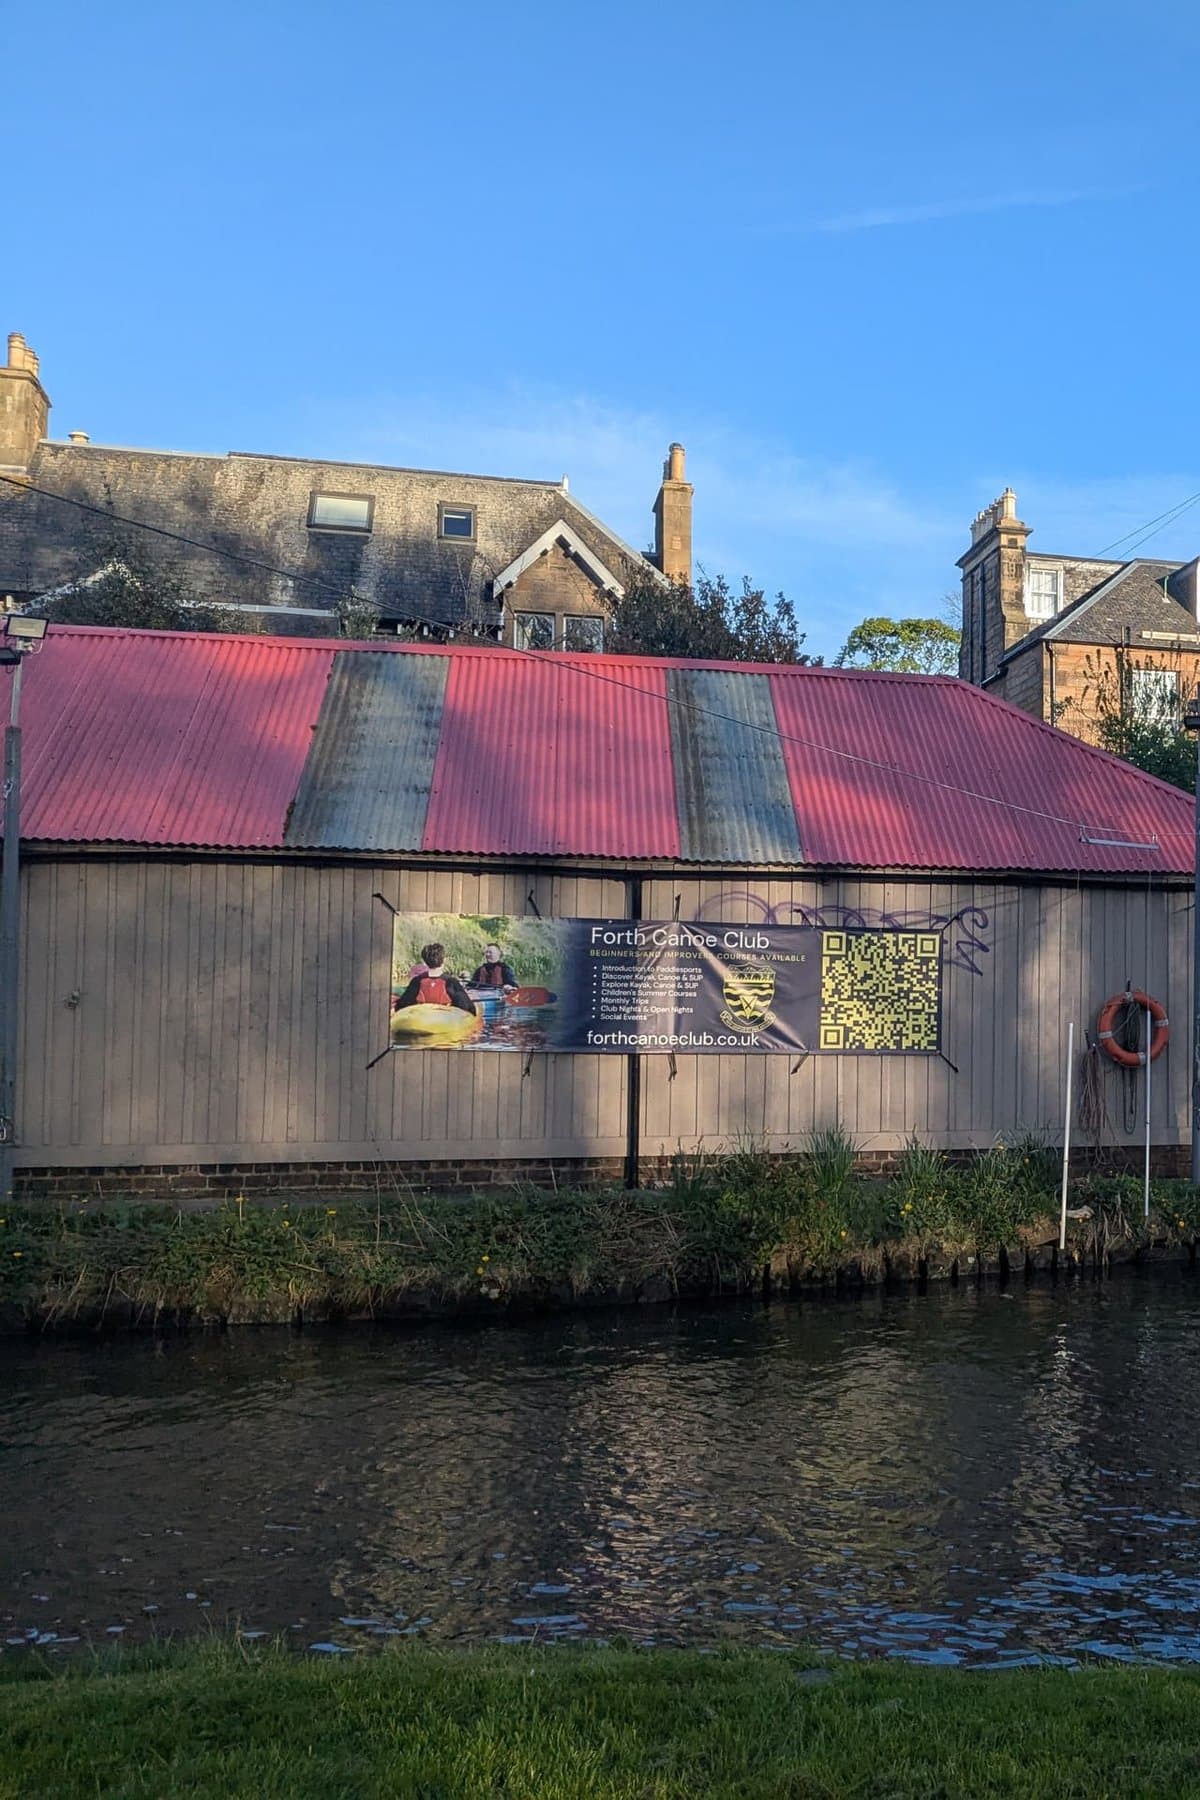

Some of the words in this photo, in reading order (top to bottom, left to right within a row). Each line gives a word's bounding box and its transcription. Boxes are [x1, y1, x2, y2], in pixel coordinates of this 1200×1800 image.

[591, 927, 645, 945] Forth
[652, 929, 718, 947] Canoe
[724, 931, 769, 949] Club
[590, 950, 639, 958] BEGINNERS
[643, 950, 661, 958] AND
[717, 952, 757, 961] COURSES
[760, 953, 806, 962] AVAILABLE
[656, 966, 702, 974] Paddlesports
[602, 981, 628, 989] Explore
[601, 997, 629, 1005] Monthly
[650, 1006, 671, 1014] Open
[587, 1030, 760, 1046] forthcanoeclub.co.uk
